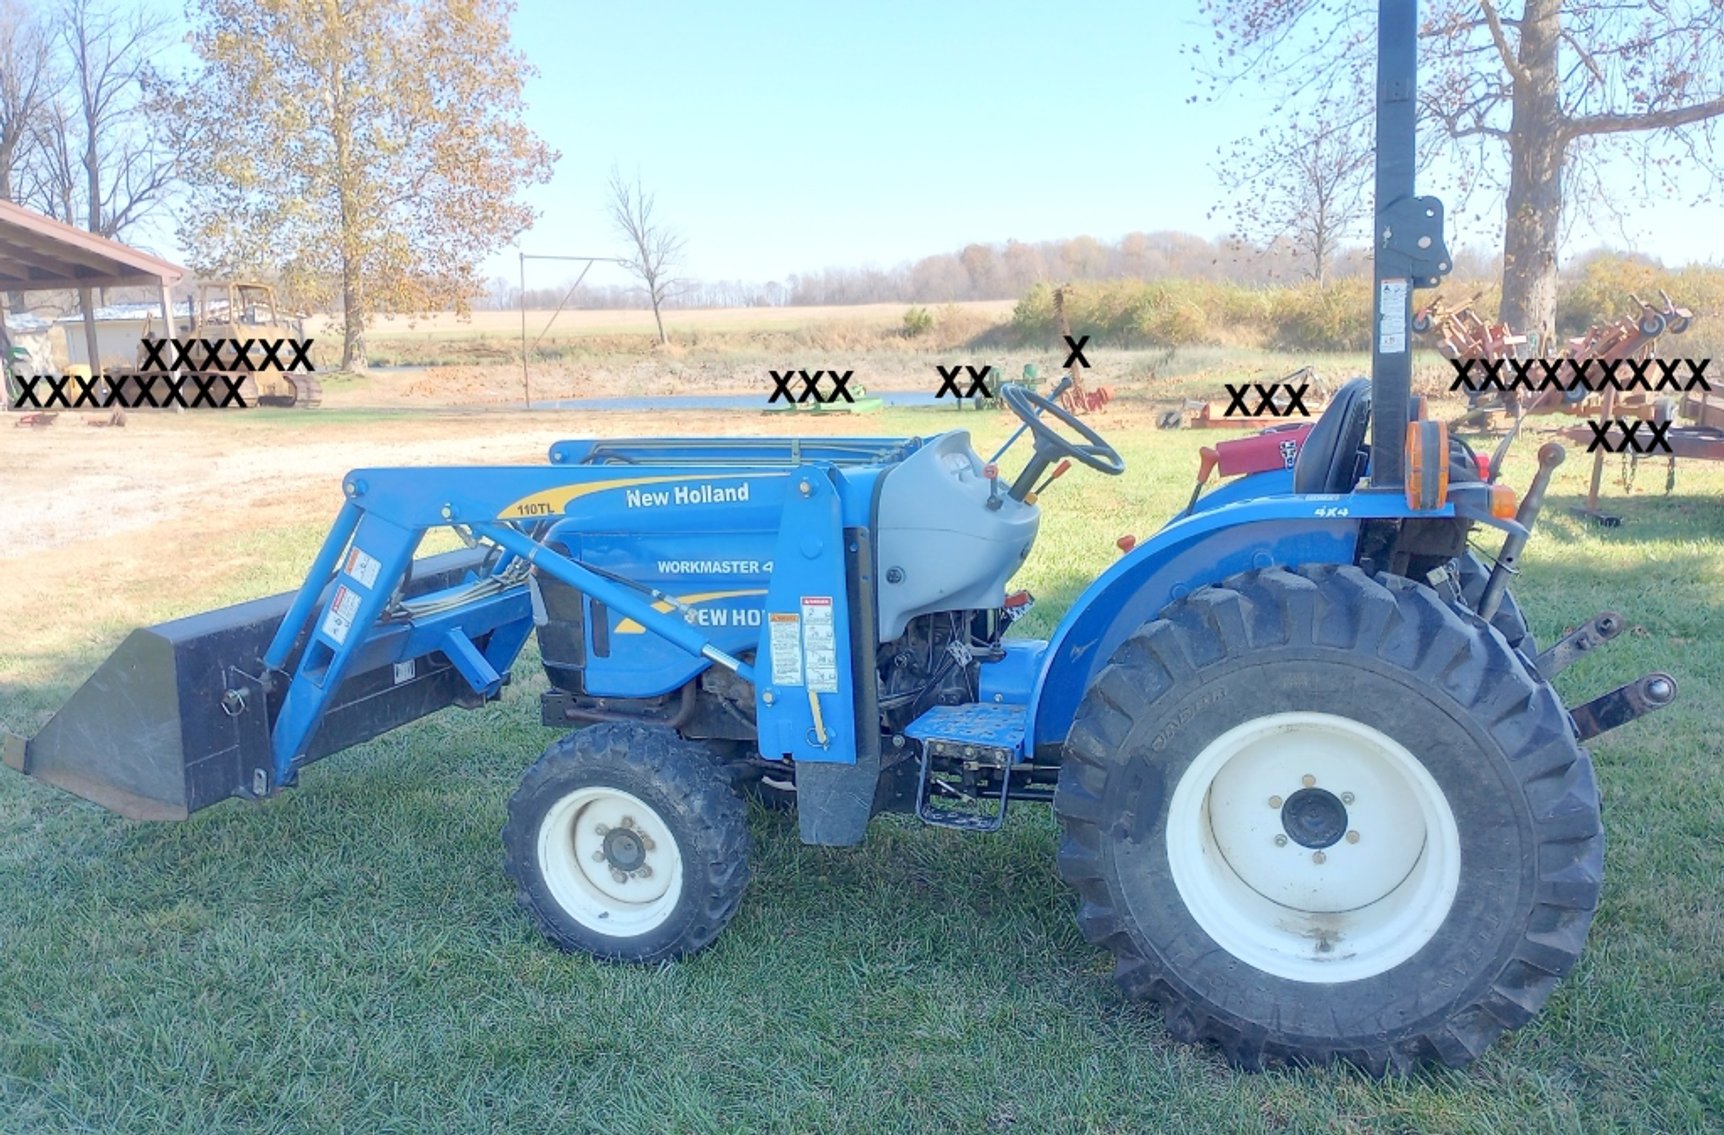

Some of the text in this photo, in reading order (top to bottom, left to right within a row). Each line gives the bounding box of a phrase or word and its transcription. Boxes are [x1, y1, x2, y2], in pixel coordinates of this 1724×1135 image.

[626, 482, 749, 508] New Holland
[517, 503, 555, 516] 110TL
[657, 560, 759, 574] WORKMASTER
[697, 608, 766, 626] EW HO
